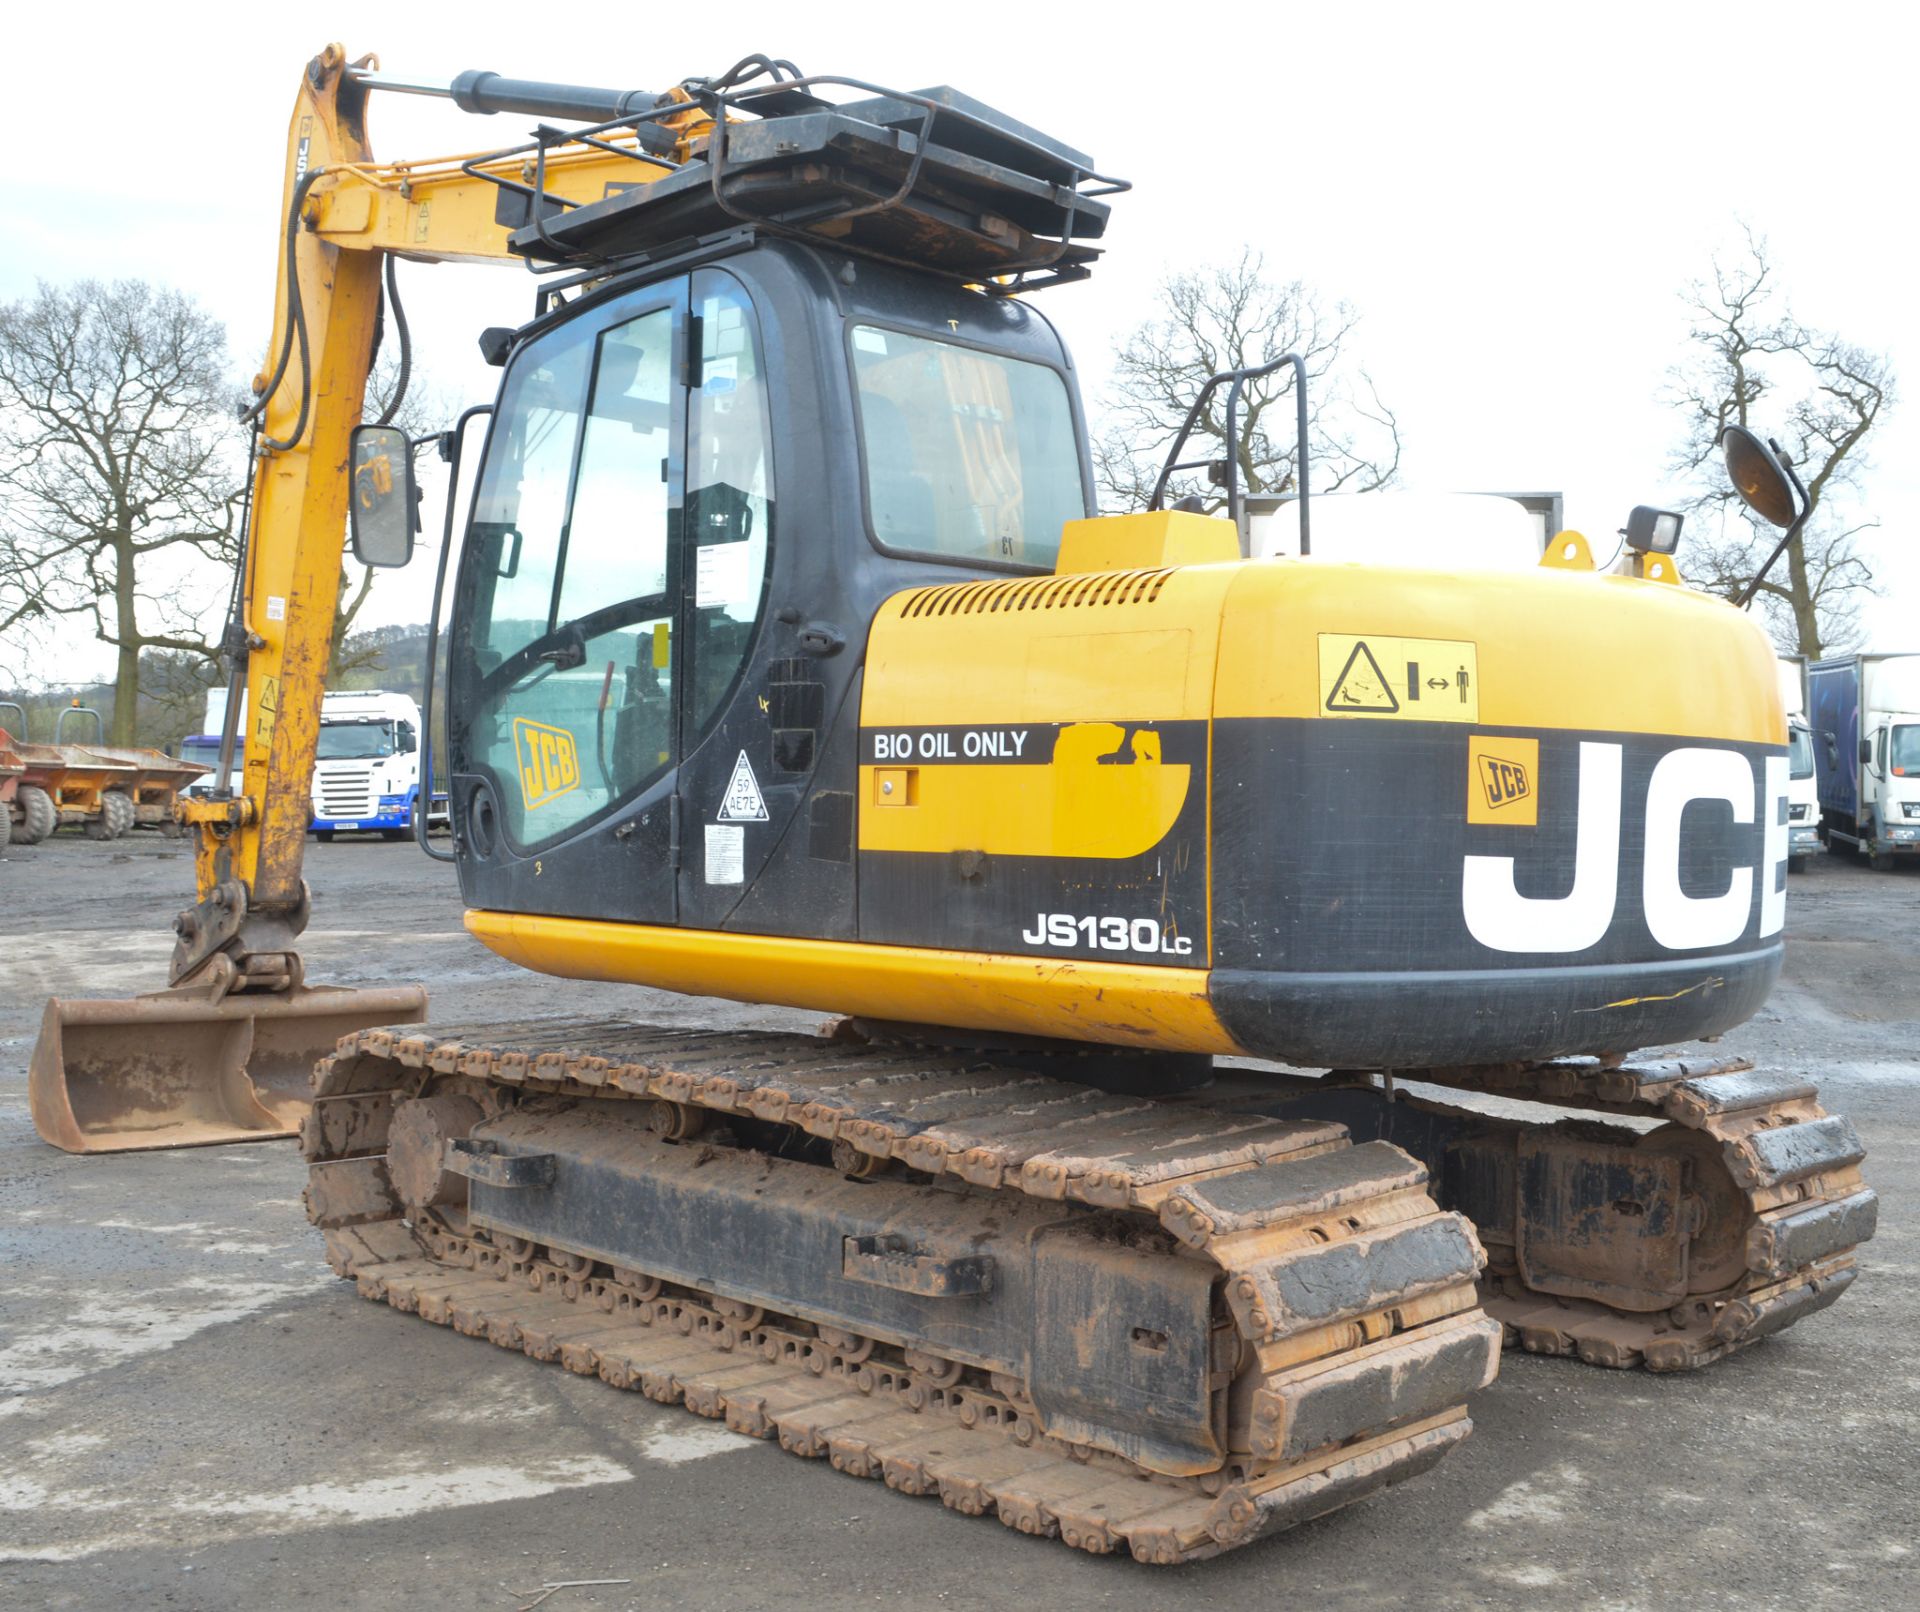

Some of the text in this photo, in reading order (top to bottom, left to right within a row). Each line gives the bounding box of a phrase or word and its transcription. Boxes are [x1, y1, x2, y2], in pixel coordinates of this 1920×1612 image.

[874, 730, 1028, 759] BIO OIL ONLY
[524, 727, 575, 799] JCB
[737, 778, 750, 793] 59
[1487, 761, 1527, 803] JCB
